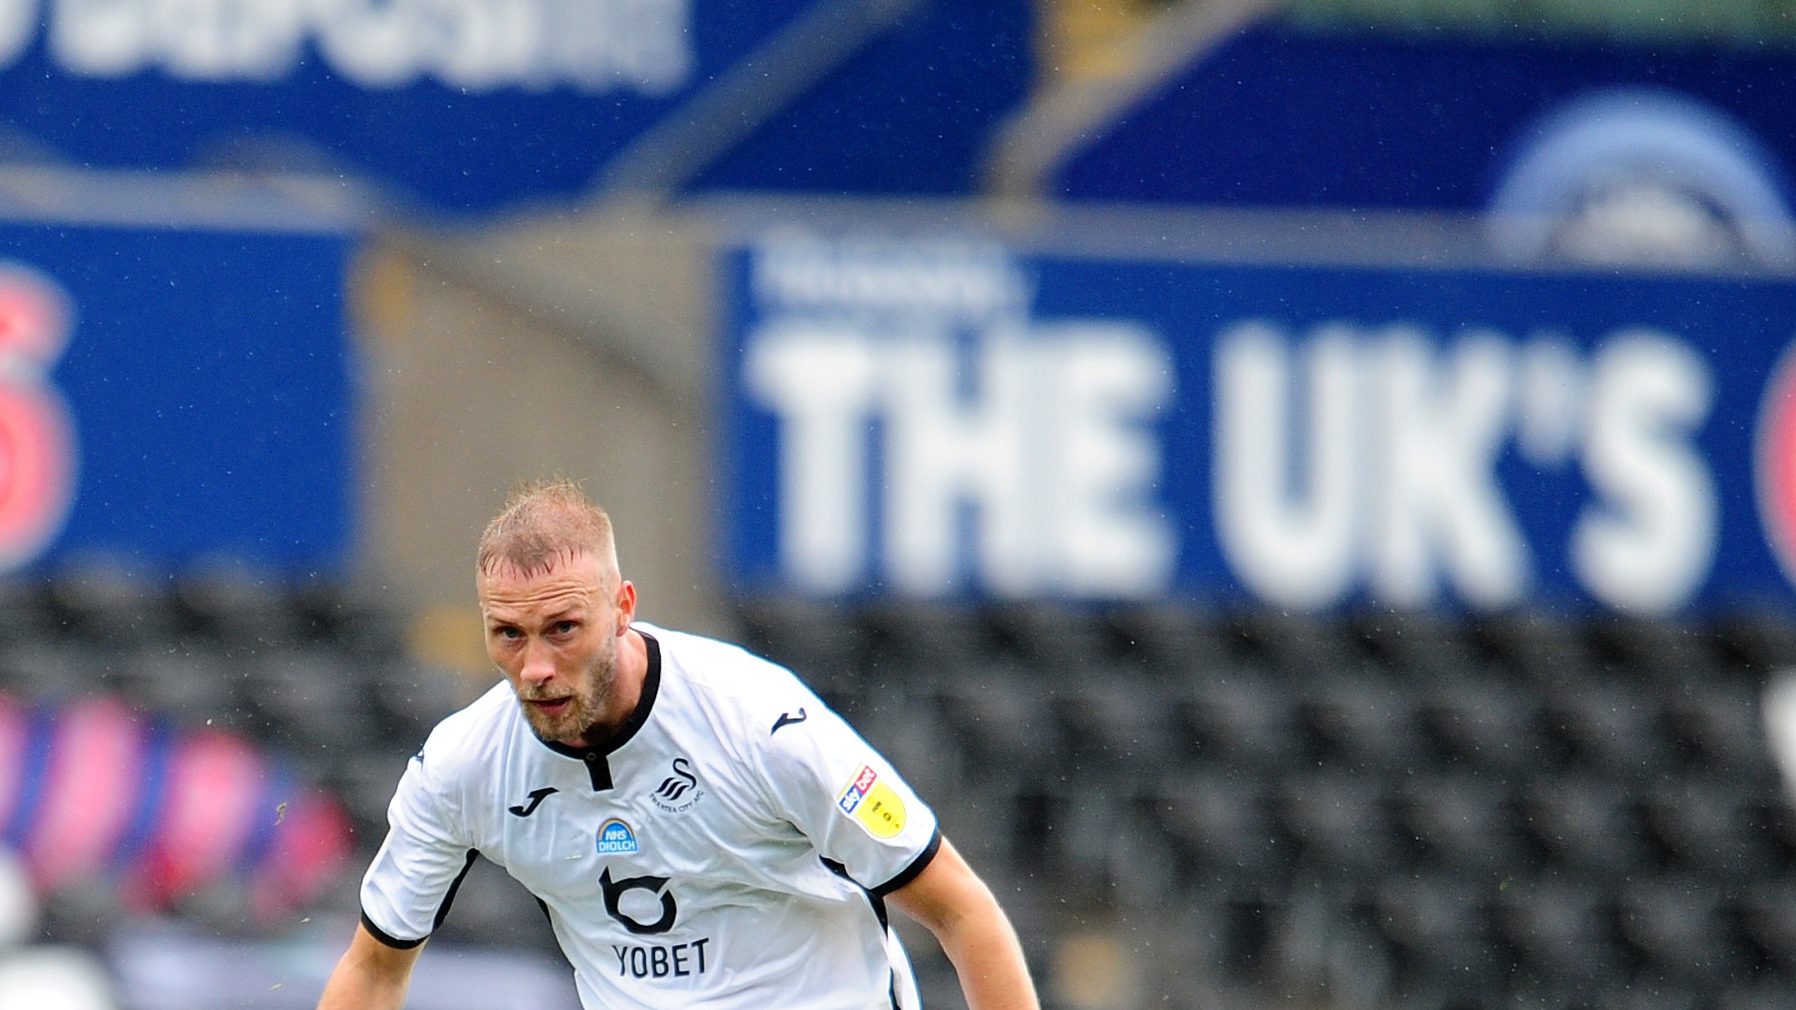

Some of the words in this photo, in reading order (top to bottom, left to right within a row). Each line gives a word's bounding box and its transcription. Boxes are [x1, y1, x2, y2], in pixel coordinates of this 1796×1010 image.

[747, 318, 1176, 598] THE
[1208, 320, 1724, 615] UK'S
[598, 839, 636, 852] DIOLCH
[605, 829, 627, 841] NHS
[611, 937, 710, 979] YOBET
